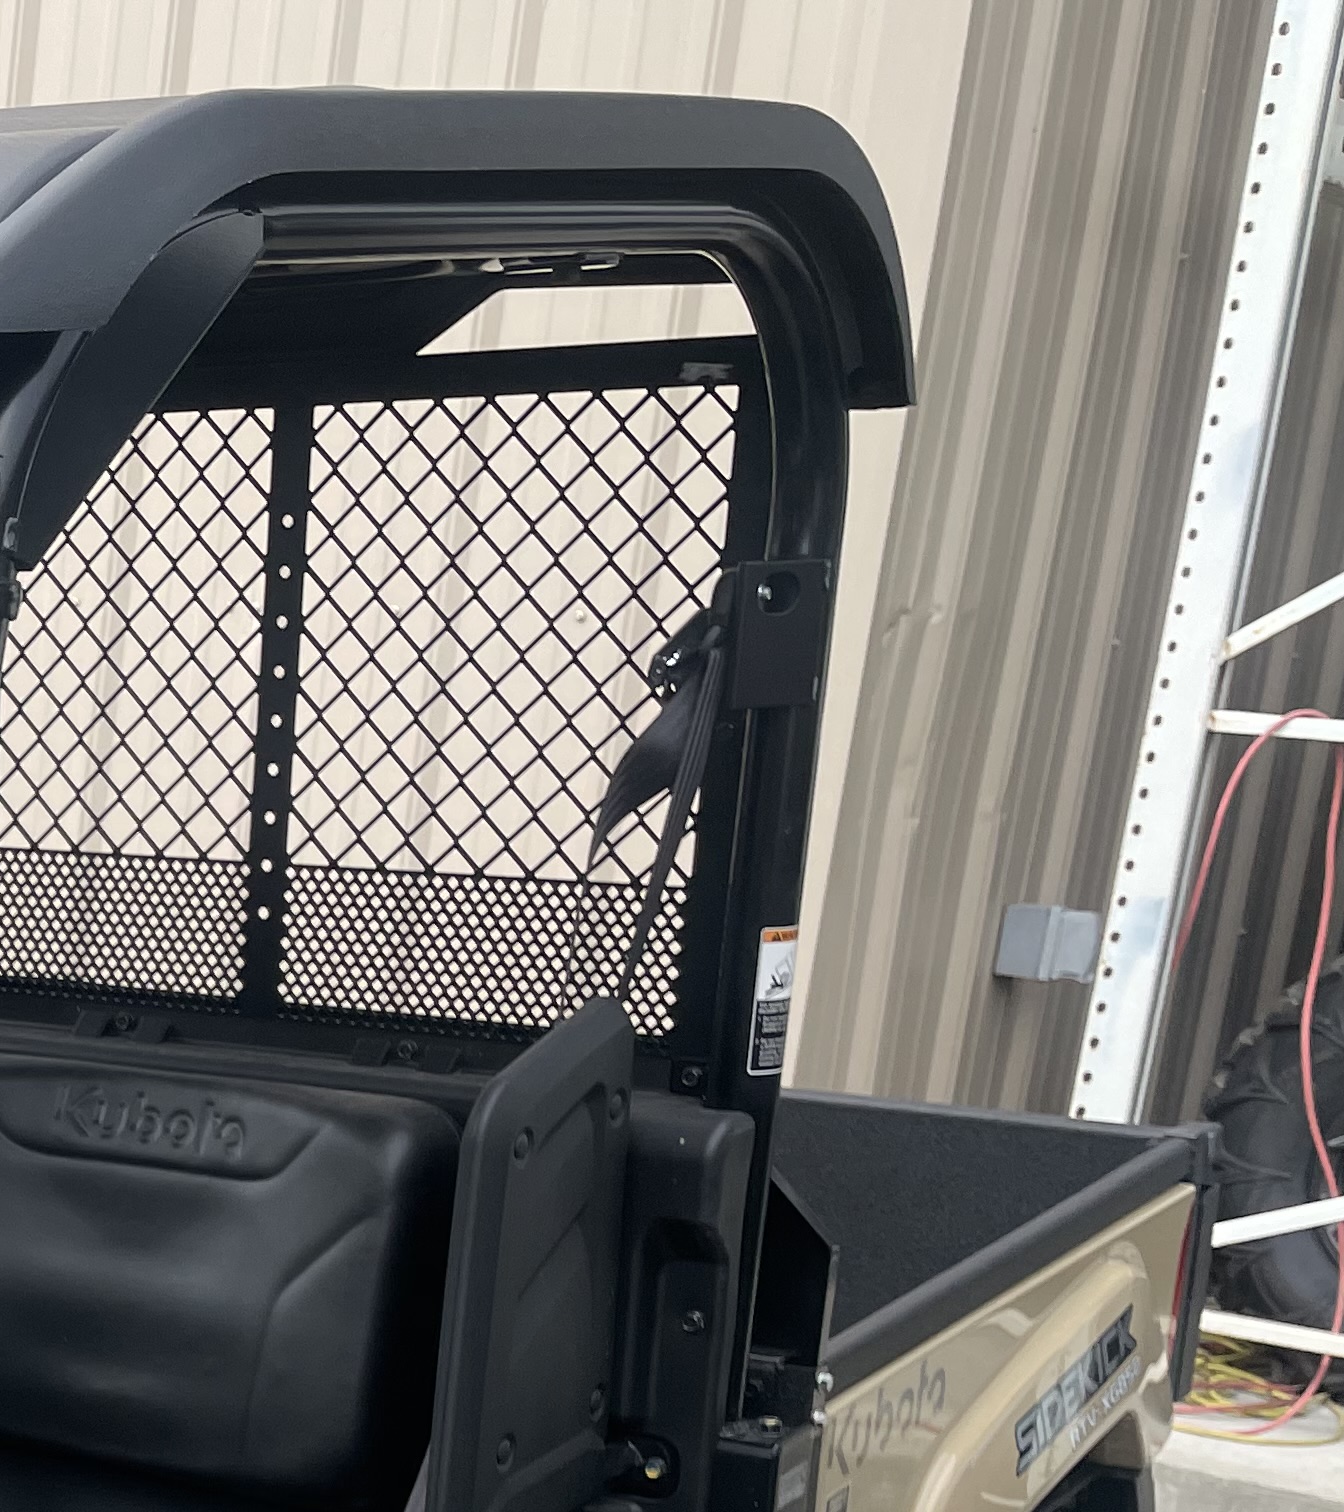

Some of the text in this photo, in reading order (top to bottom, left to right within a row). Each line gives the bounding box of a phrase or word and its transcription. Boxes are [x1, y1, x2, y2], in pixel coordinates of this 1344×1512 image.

[54, 1085, 246, 1160] Kubota
[827, 1360, 946, 1475] Kubota
[1015, 1303, 1136, 1477] SIDEKICK
